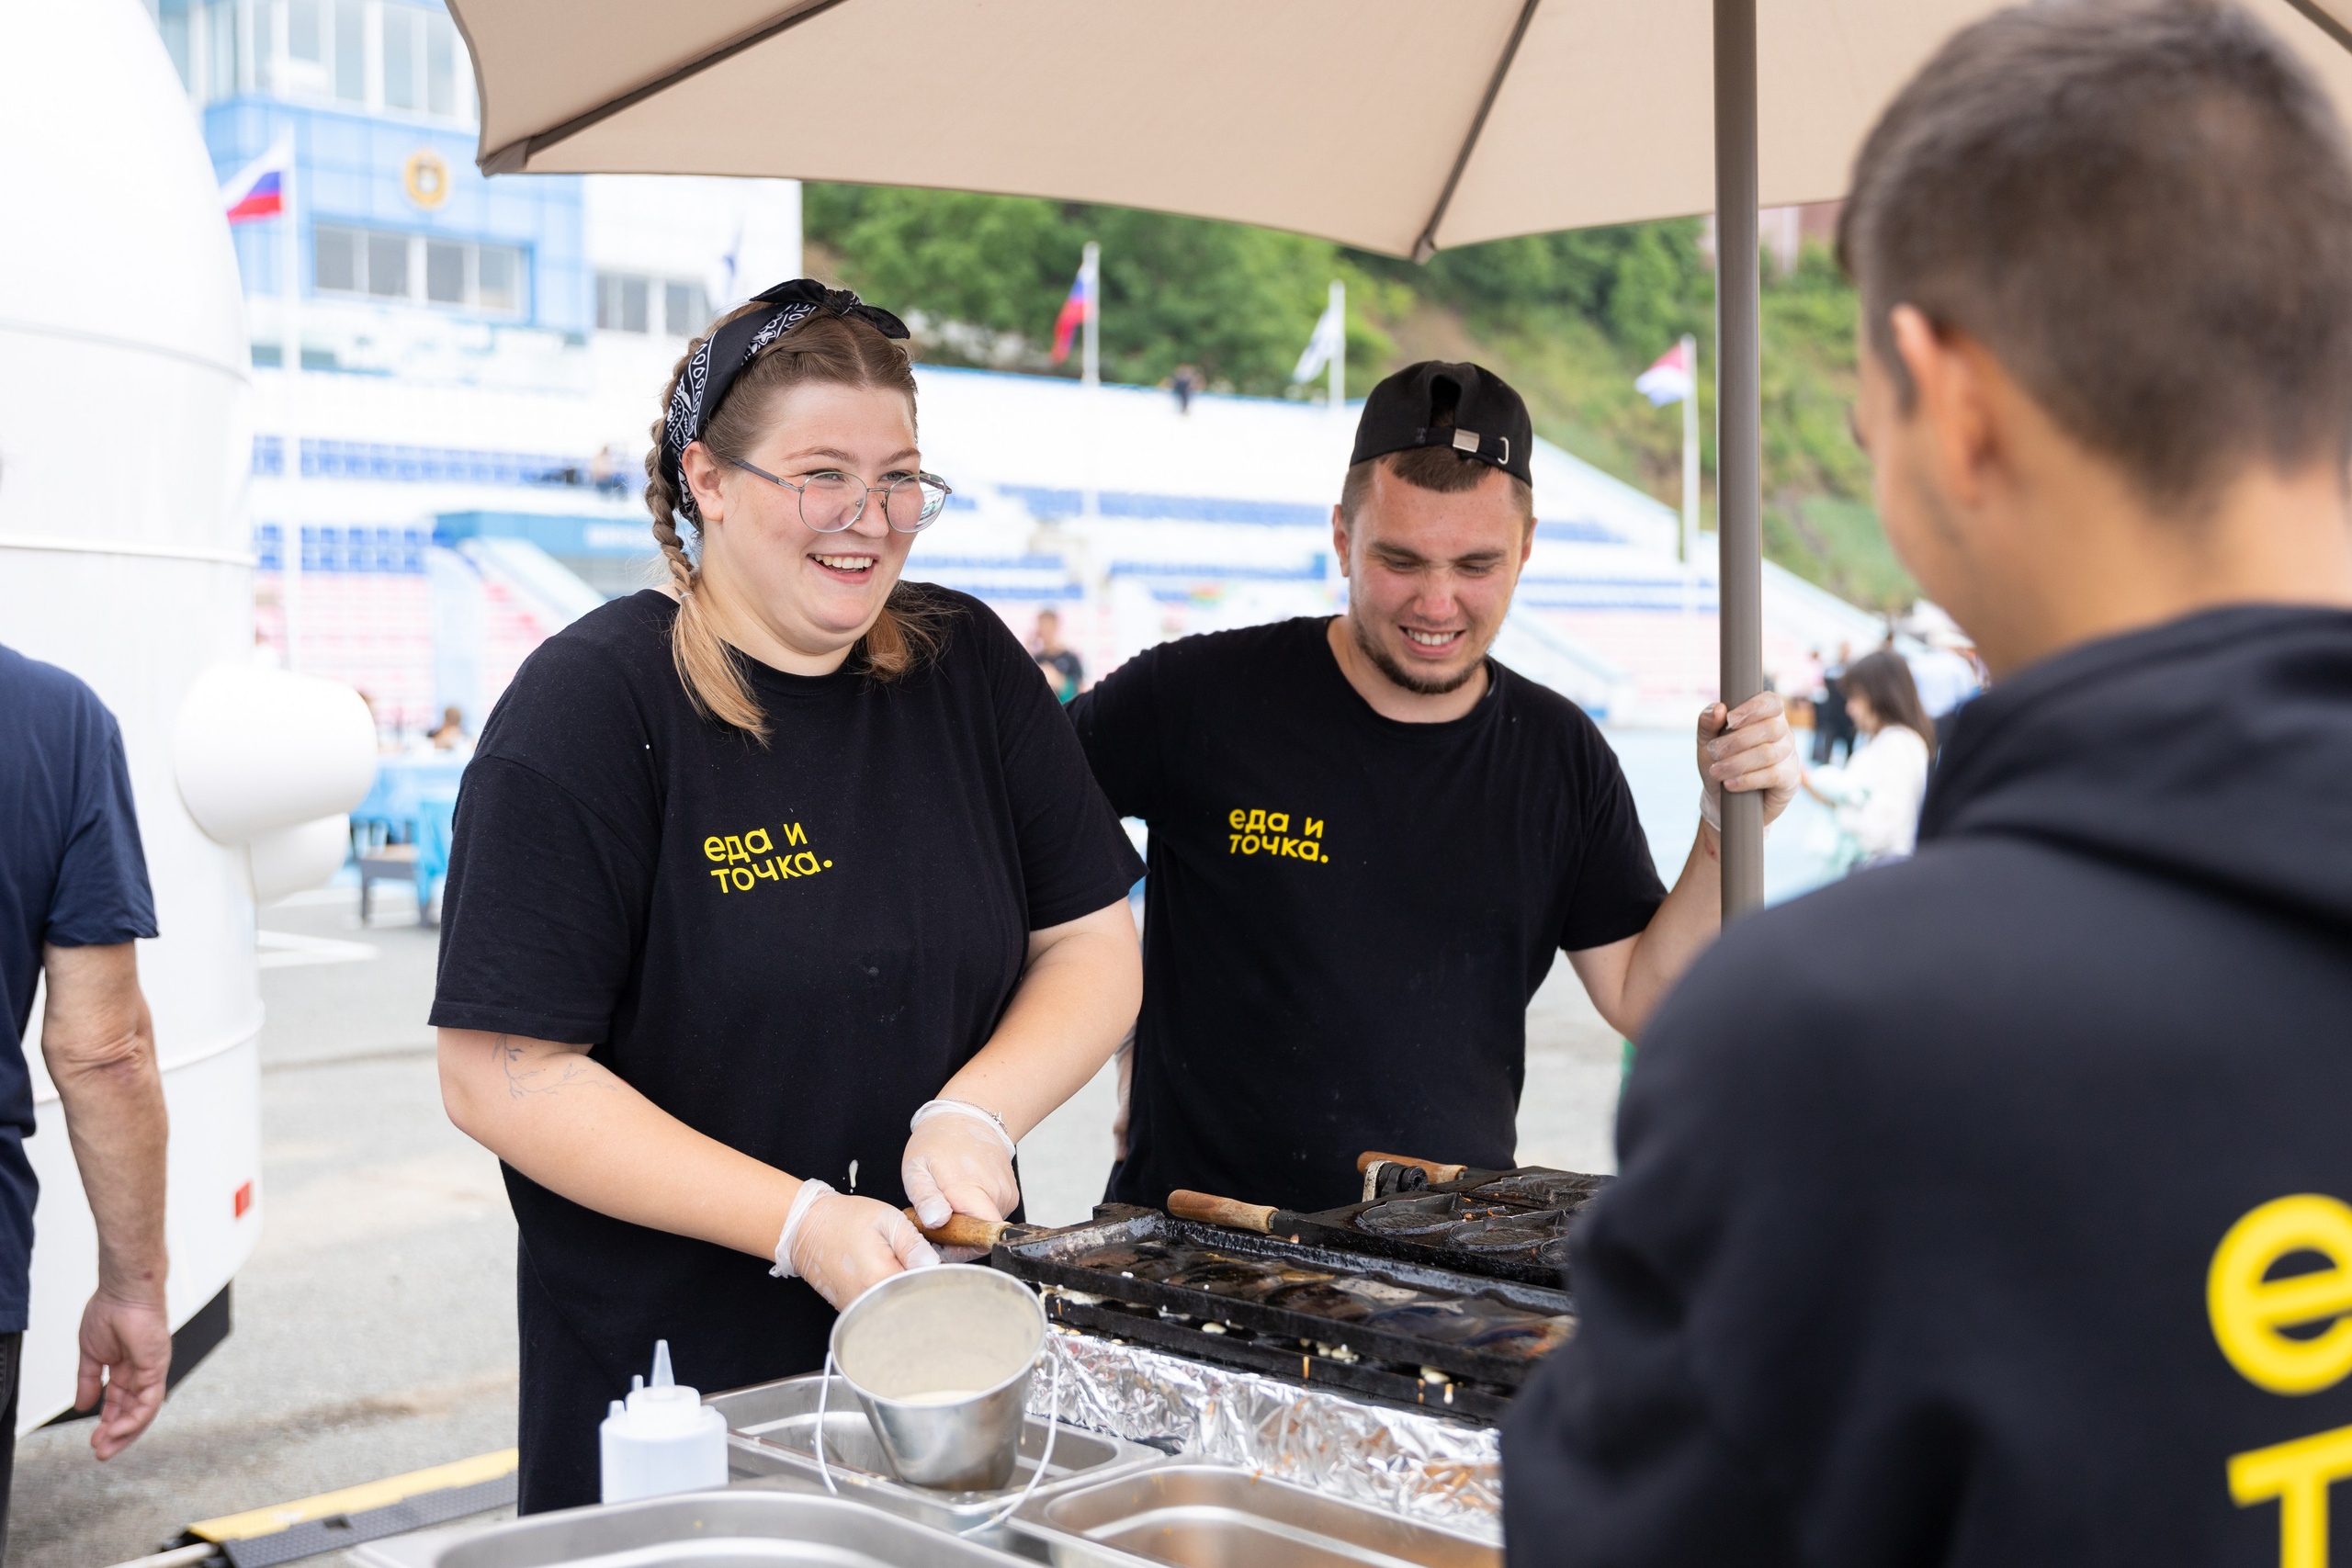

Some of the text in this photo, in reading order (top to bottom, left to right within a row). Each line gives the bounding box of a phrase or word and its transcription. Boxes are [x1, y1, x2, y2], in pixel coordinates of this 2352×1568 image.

[1228, 808, 1324, 839] еда и
[704, 822, 808, 866] еда и
[1228, 834, 1329, 863] точка.
[710, 851, 833, 894] точка.
